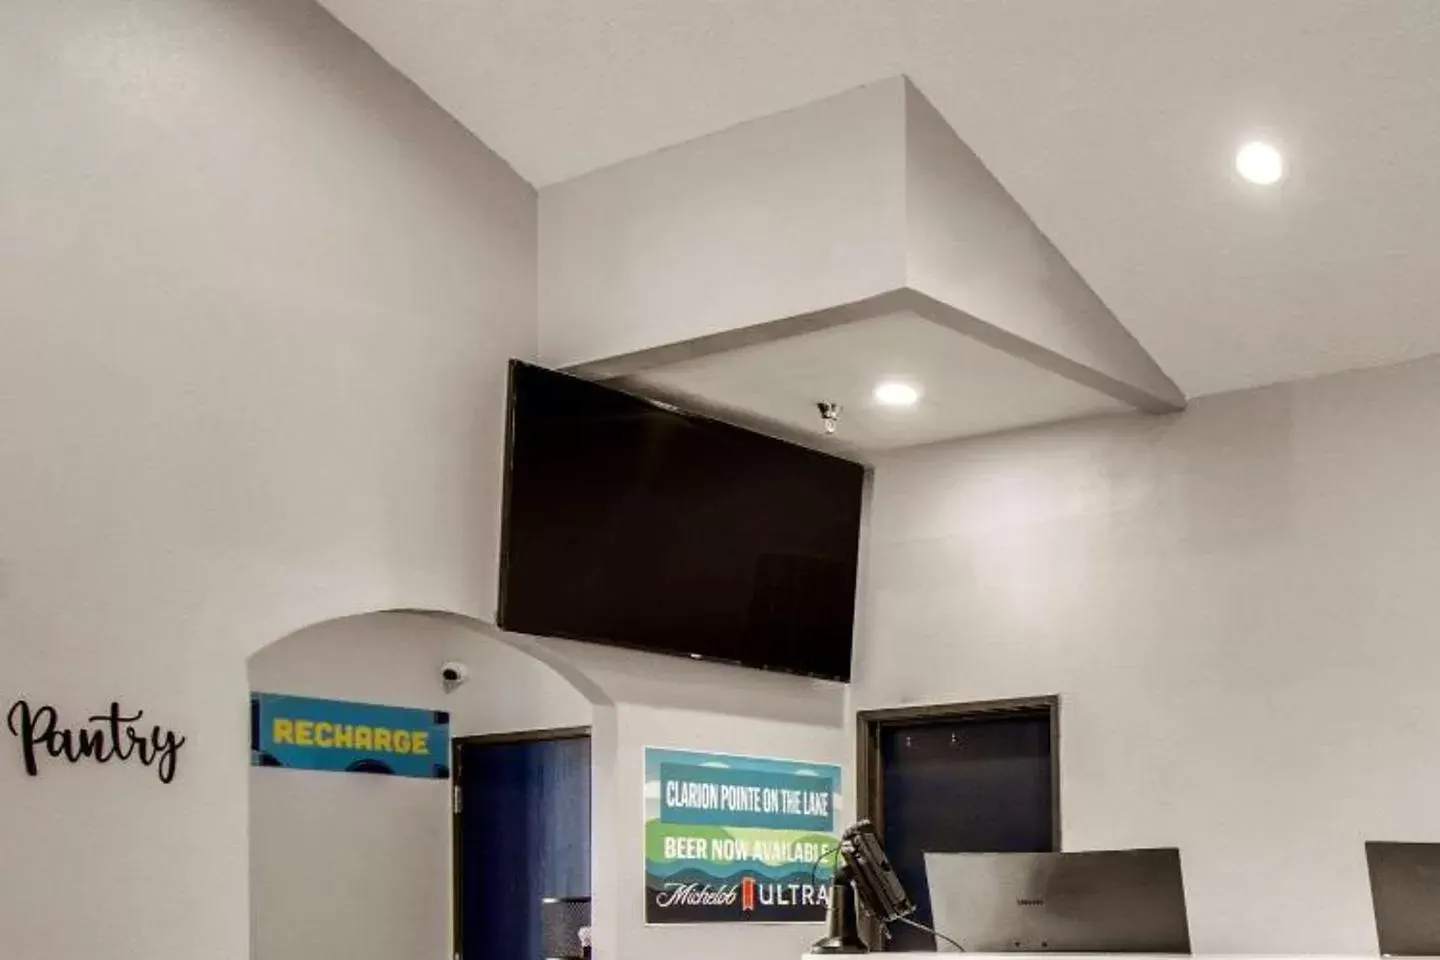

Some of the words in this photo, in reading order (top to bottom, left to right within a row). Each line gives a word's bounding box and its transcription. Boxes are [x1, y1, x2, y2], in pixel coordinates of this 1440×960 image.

[7, 700, 186, 784] Pantry
[272, 718, 431, 756] RECHARGE
[666, 780, 718, 810] CLARION
[721, 784, 761, 813] POINTE
[763, 786, 779, 813] ON
[781, 788, 802, 815] THE
[664, 836, 707, 860] BEER
[711, 838, 750, 862] NOW
[752, 839, 830, 863] AVAILABLE
[656, 882, 738, 908] Michelob
[759, 884, 828, 905] ULTRA
